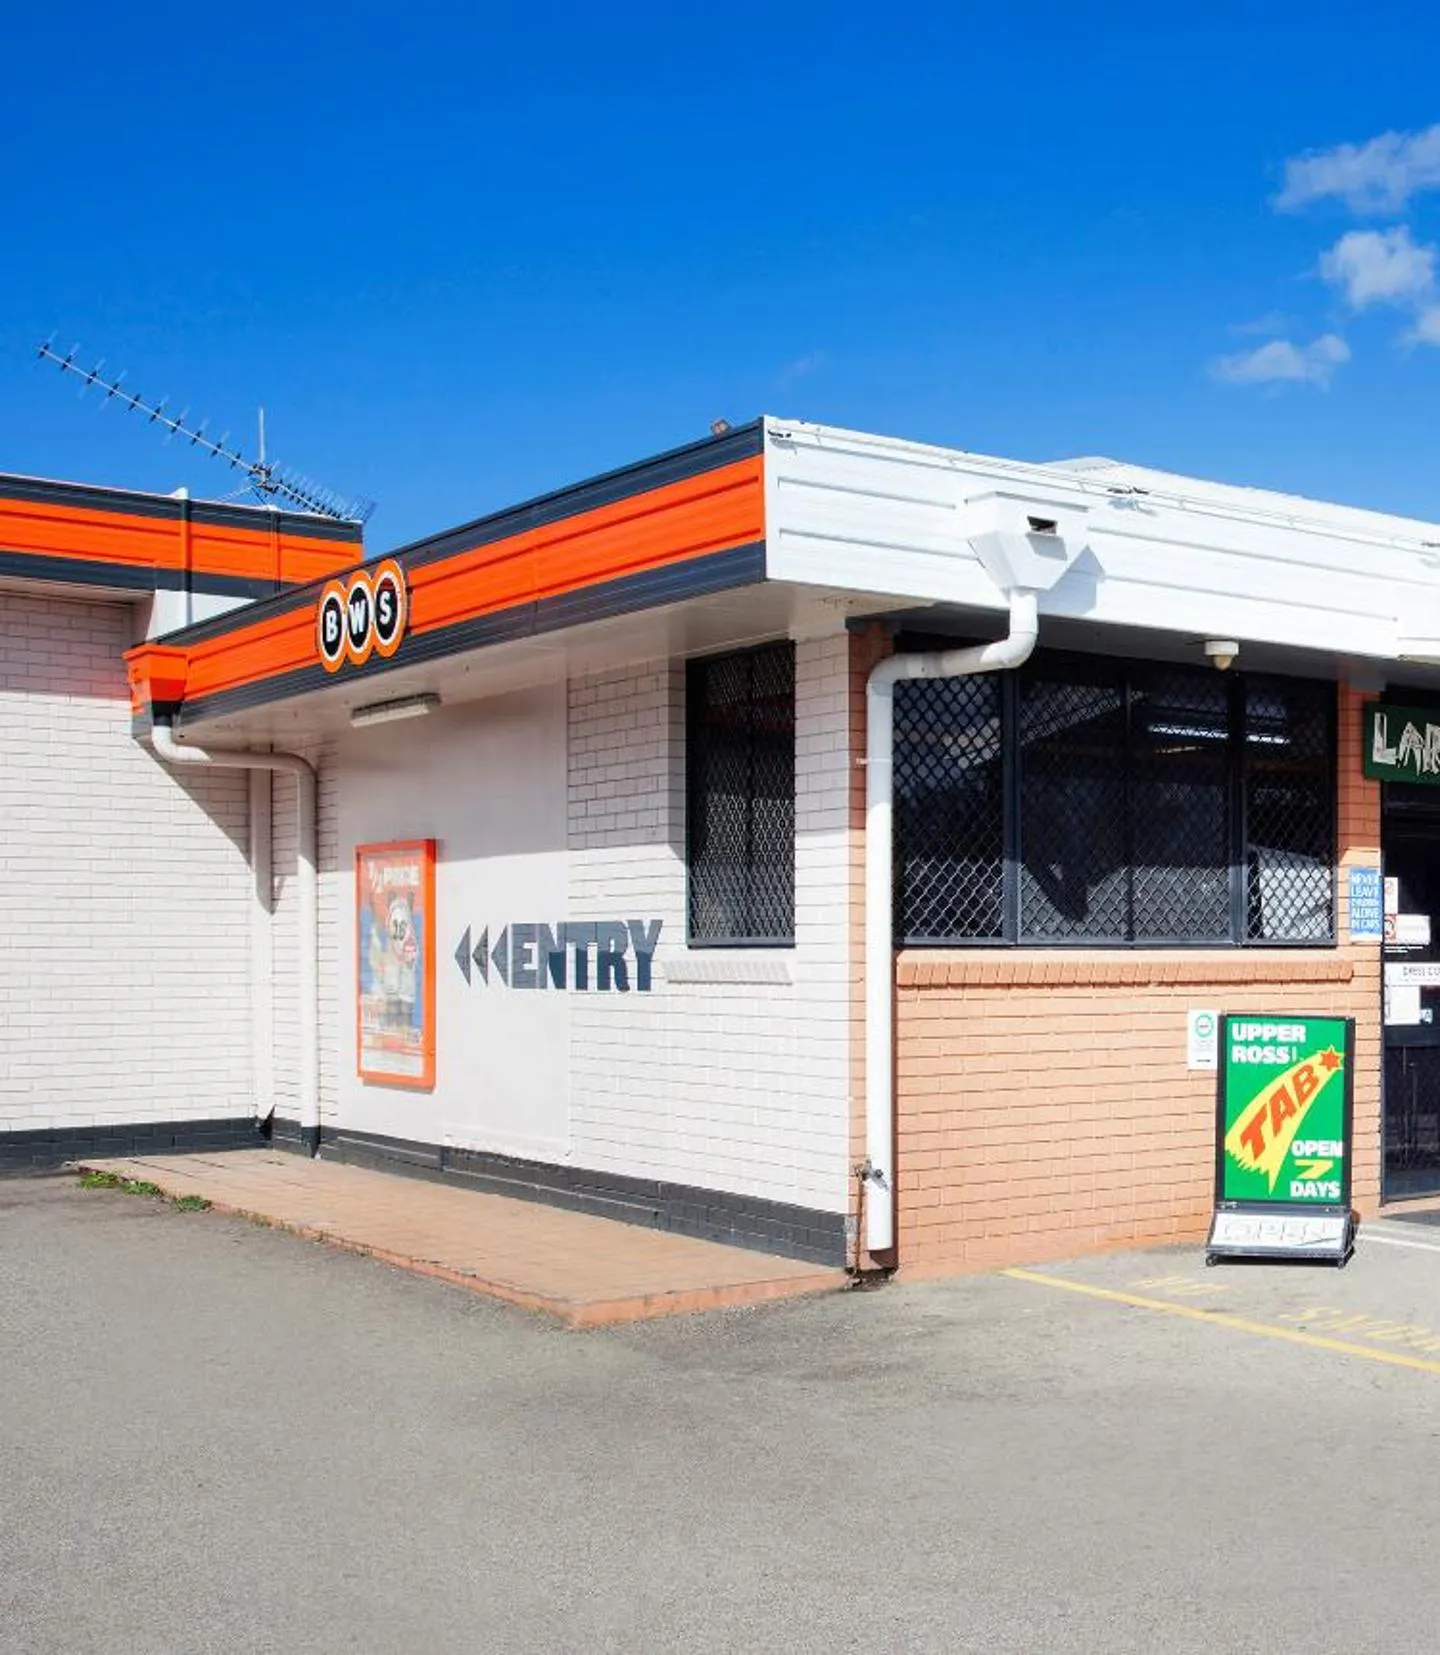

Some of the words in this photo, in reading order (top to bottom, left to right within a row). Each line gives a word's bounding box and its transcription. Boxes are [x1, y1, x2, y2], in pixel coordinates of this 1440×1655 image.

[1350, 886, 1379, 898] LEAVE
[511, 919, 664, 992] ENTRY
[1231, 1022, 1307, 1043] UPPER
[1239, 1064, 1320, 1161] TAB
[1291, 1140, 1344, 1157] OPEN
[1294, 1159, 1334, 1180] 7
[1289, 1180, 1341, 1199] DAYS
